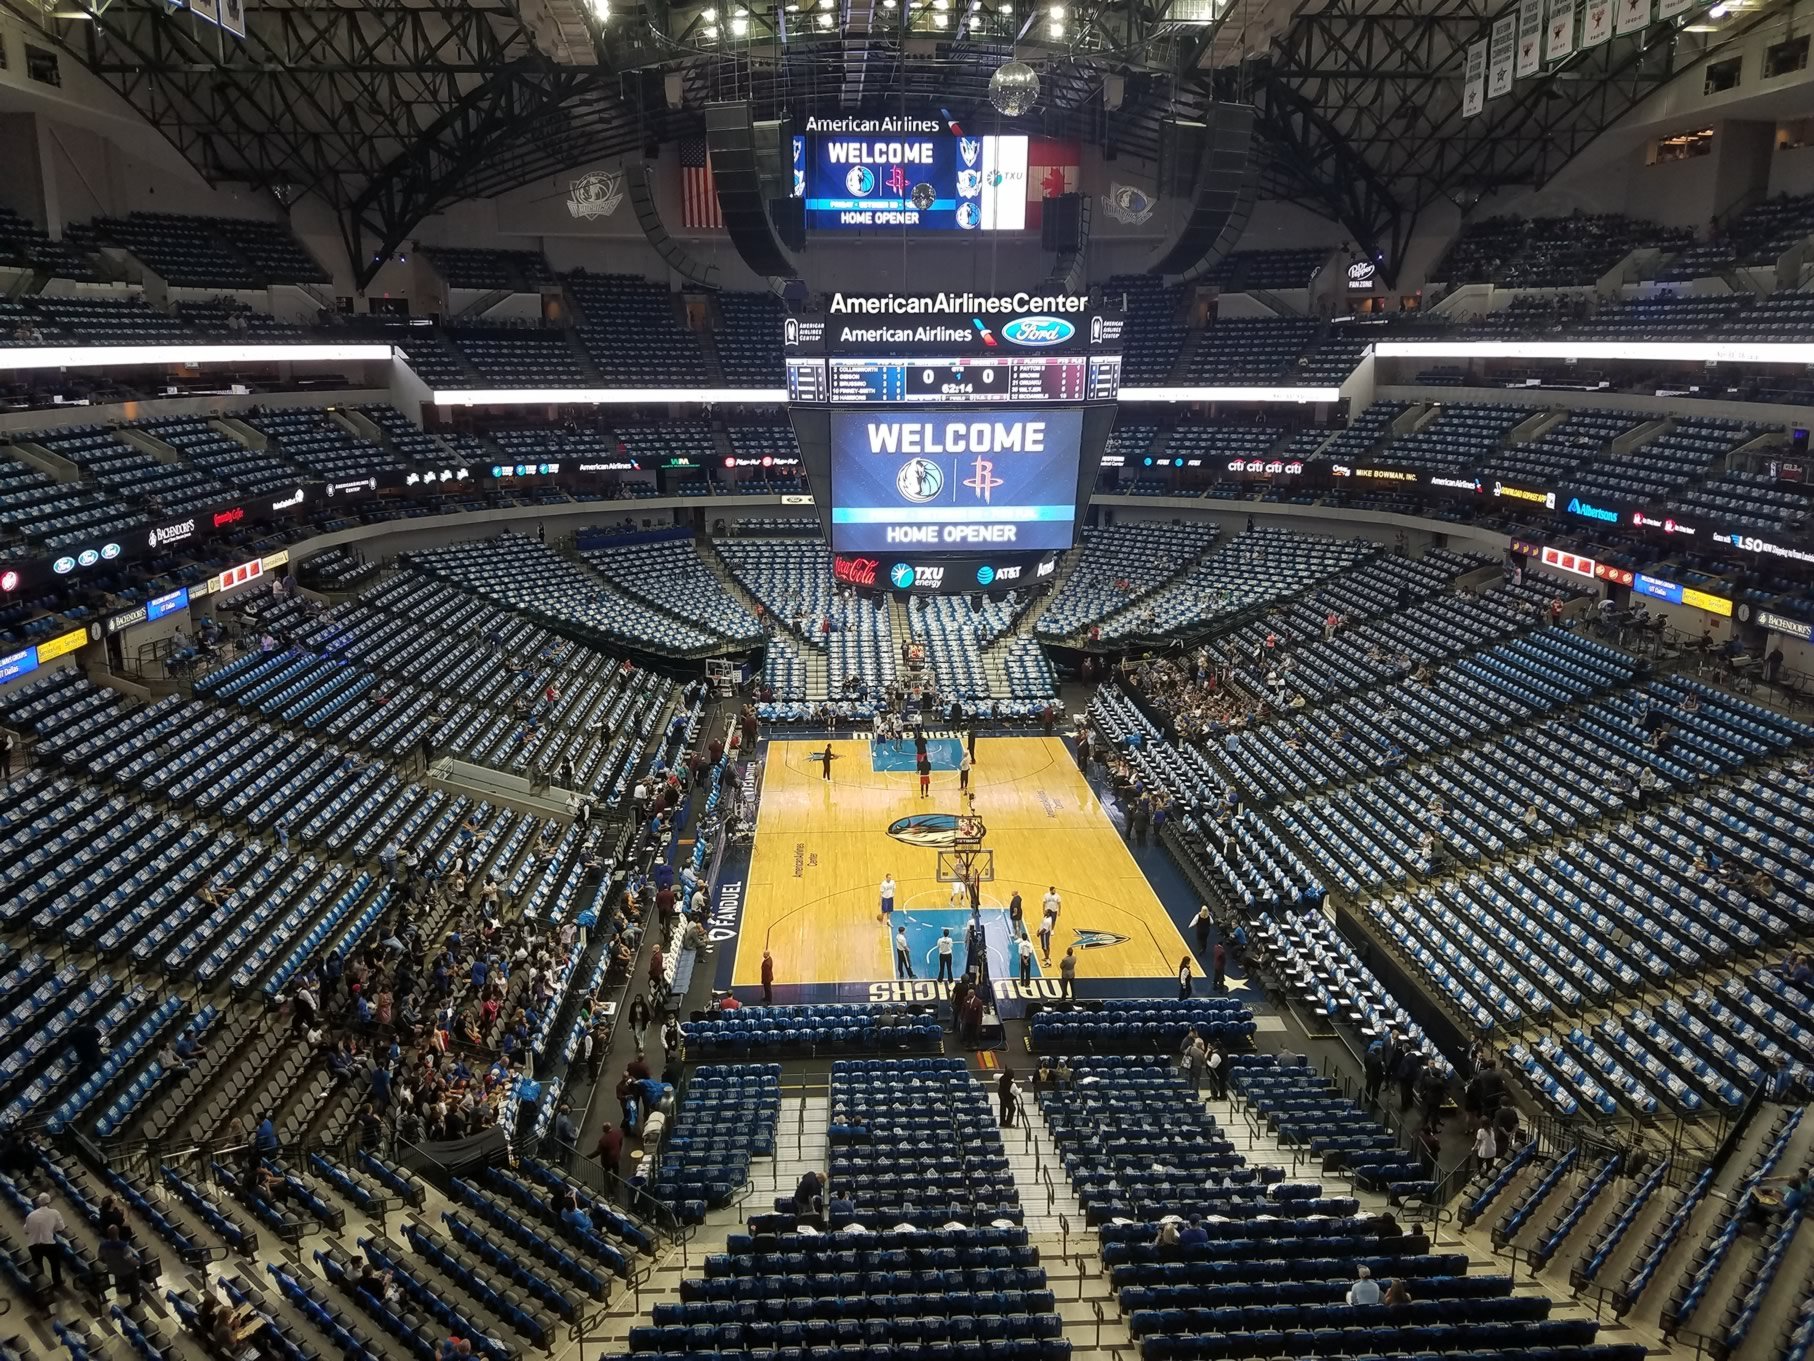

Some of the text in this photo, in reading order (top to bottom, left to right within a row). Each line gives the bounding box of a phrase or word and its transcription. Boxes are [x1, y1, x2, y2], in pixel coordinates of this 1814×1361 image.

[806, 116, 939, 132] American Airlines
[828, 142, 934, 163] WELCOME
[1004, 172, 1023, 180] TXU
[841, 211, 919, 224] HOME OPENER
[841, 325, 973, 342] American Airlines
[923, 369, 934, 384] 0
[982, 368, 994, 384] 0
[941, 383, 973, 394] 62:14
[868, 422, 1046, 453] WELCOME
[580, 462, 632, 471] American Airlines
[1228, 461, 1245, 472] citi
[1246, 461, 1264, 473] citi
[1265, 462, 1283, 474] citi
[1284, 463, 1302, 474] citi
[1356, 469, 1372, 477] MIKE
[1373, 471, 1405, 480] BOWMAN,
[1406, 474, 1417, 482] INC.
[1431, 476, 1475, 490] American Airlines
[1580, 504, 1618, 523] Albertsons
[887, 525, 1016, 543] HOME OPENER
[1739, 535, 1763, 553] LSO
[914, 566, 945, 580] TXU
[995, 566, 1022, 580] AT&T
[914, 578, 942, 589] energy
[719, 880, 742, 927] FANDUEL
